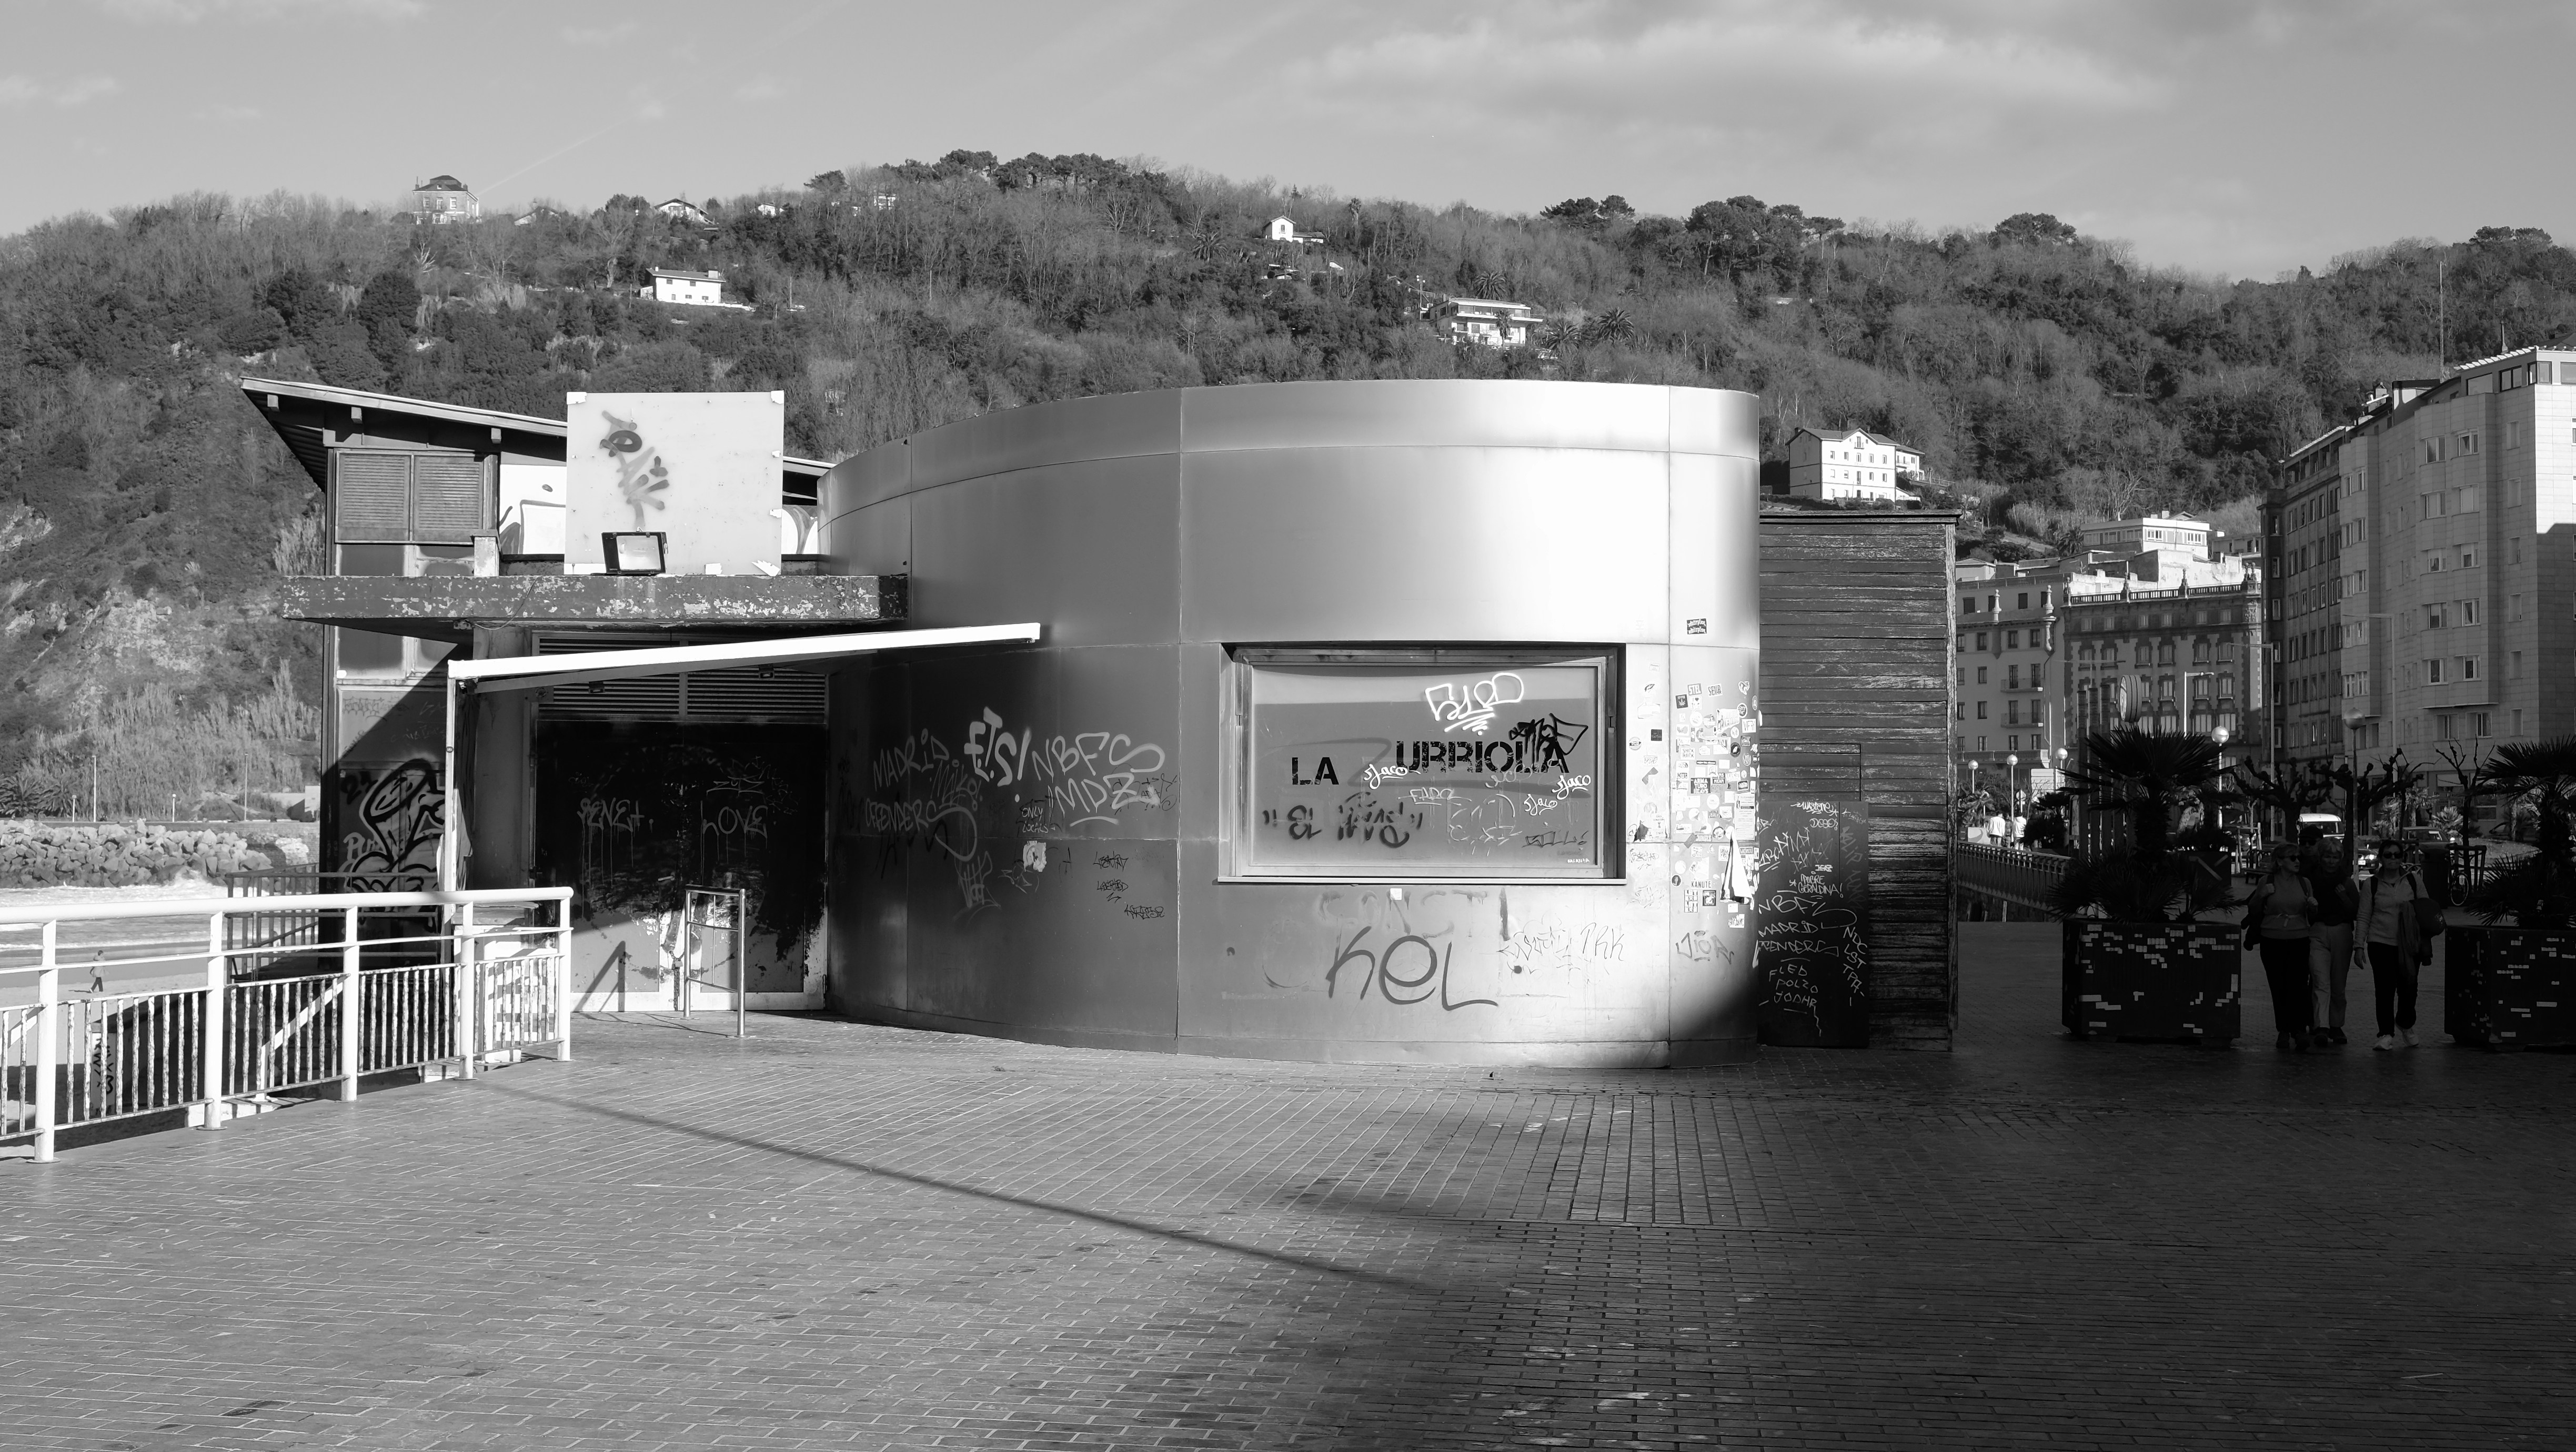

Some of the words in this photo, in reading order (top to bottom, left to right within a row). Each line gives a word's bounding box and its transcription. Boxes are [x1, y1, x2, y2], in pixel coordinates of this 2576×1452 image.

[1291, 757, 1340, 785] LA
[1021, 806, 1043, 822] ONLY
[1690, 880, 1712, 889] KANUTE
